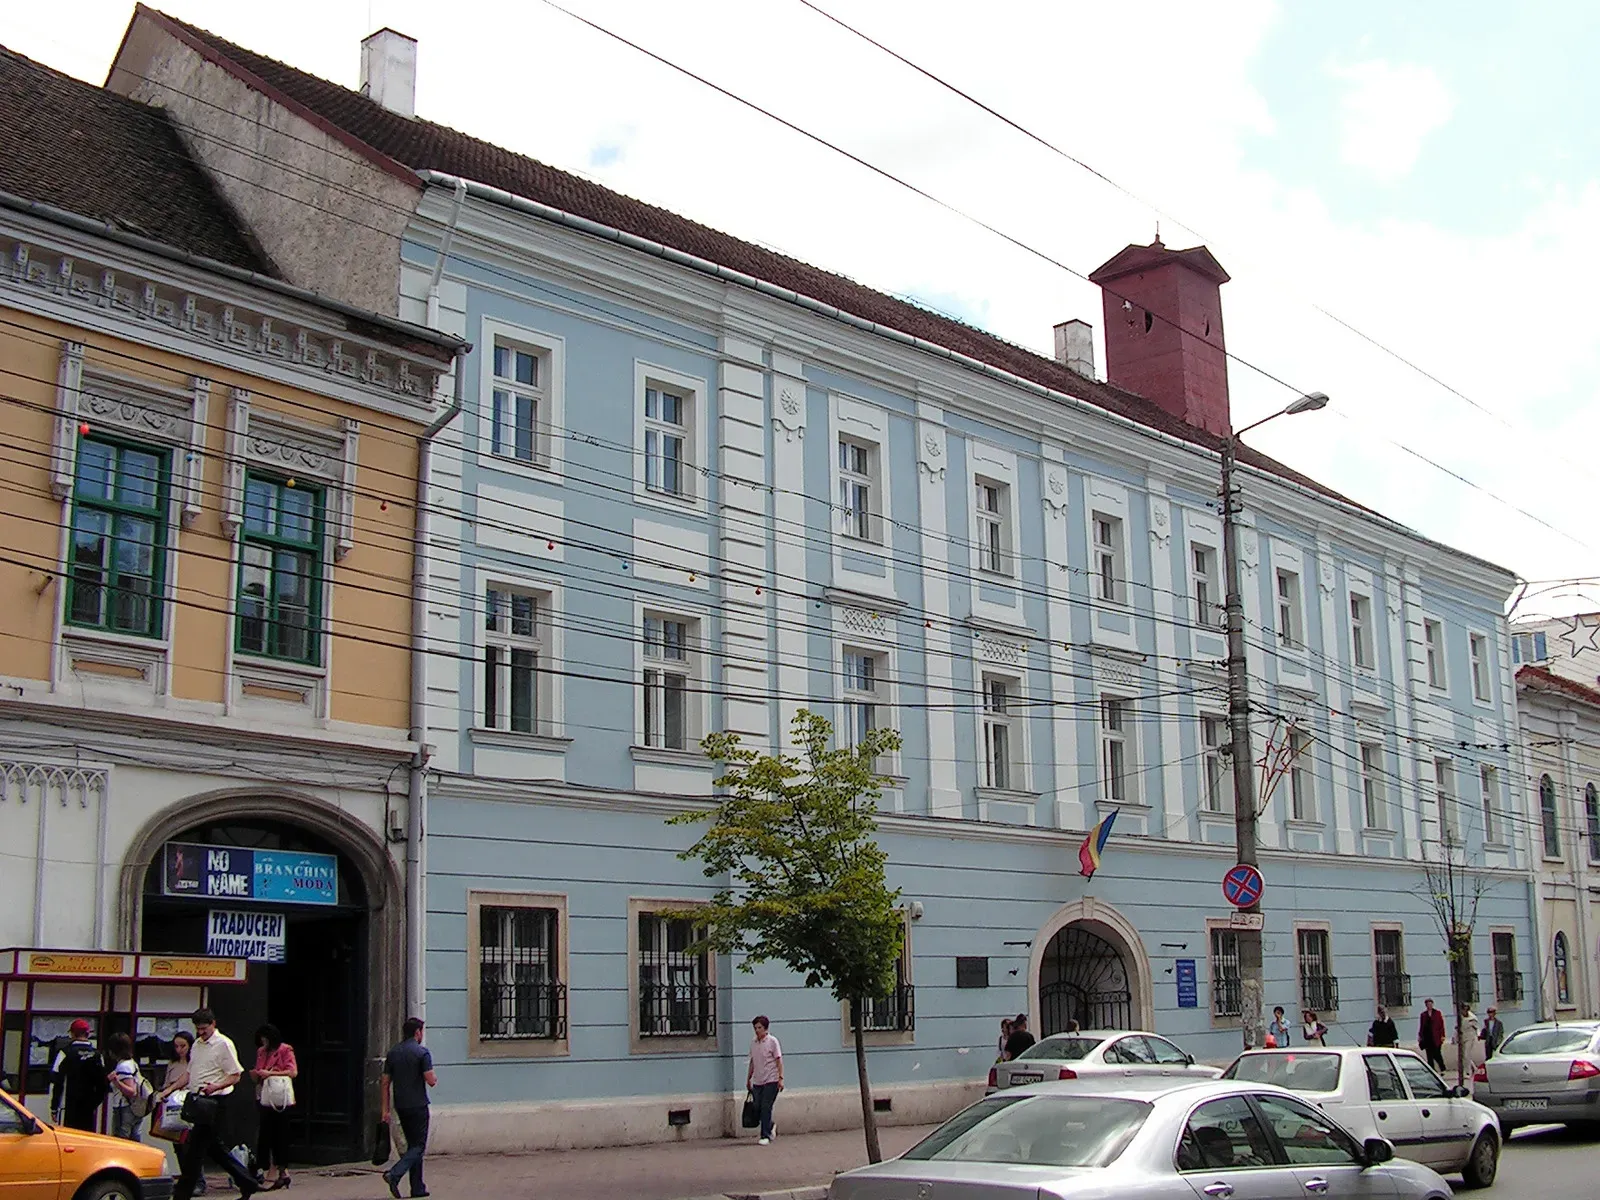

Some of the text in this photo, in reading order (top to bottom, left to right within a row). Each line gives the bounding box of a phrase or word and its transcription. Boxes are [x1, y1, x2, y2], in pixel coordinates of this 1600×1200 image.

[208, 850, 229, 872] NO
[255, 863, 334, 878] BRANCHINI
[208, 873, 249, 895] NAME
[293, 878, 333, 890] MODA
[213, 912, 282, 937] TRADUCERI
[208, 938, 266, 957] AUTORIZATE
